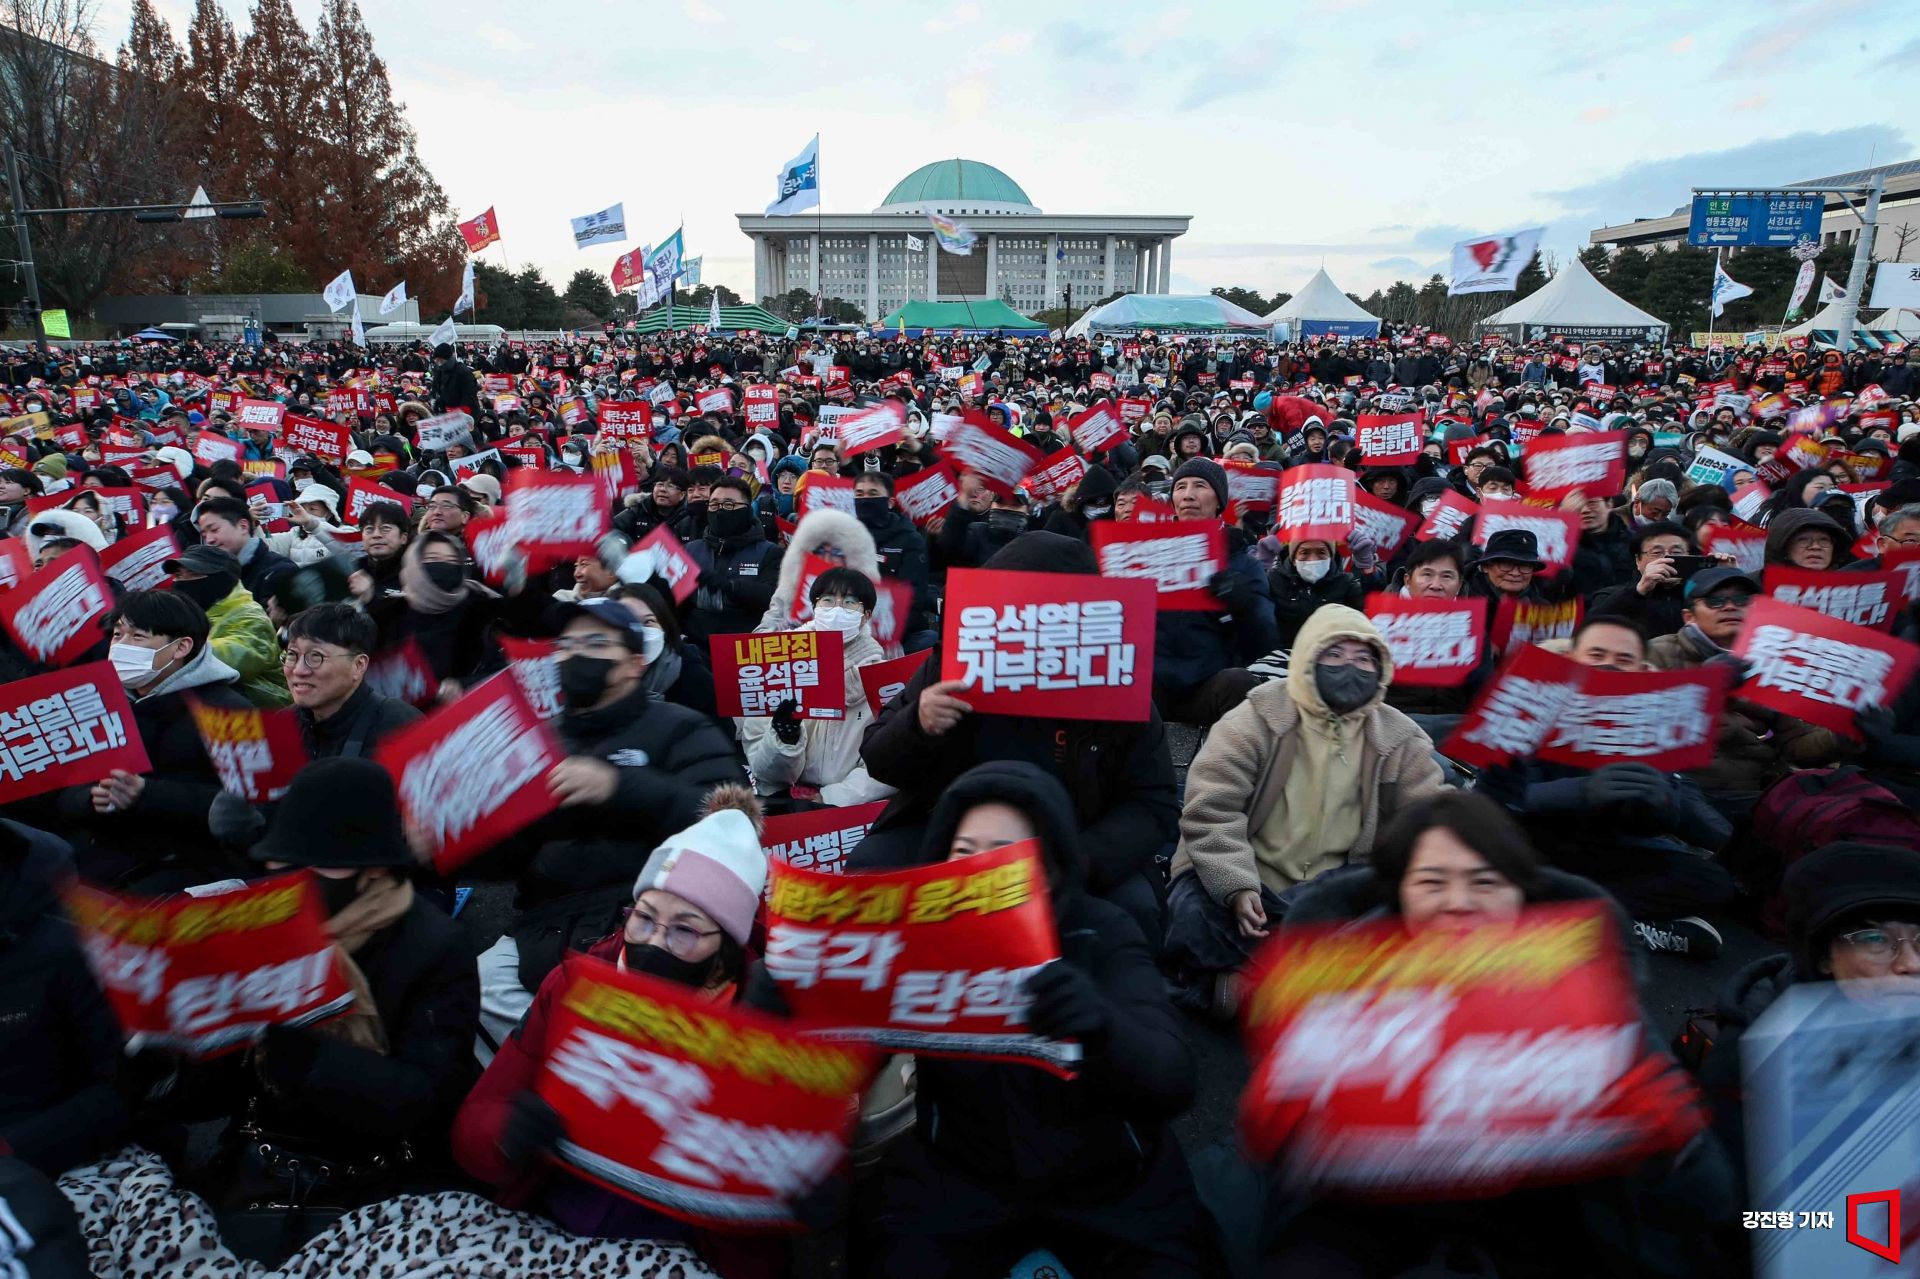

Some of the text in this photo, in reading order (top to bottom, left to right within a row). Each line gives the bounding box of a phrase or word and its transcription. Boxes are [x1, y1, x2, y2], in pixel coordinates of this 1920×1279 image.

[1769, 200, 1814, 211] 신촌로터리
[1706, 217, 1749, 227] 영등포경찰서
[1767, 217, 1802, 226] 서강대교
[1610, 327, 1624, 336] 합동
[1625, 327, 1644, 336] 분향소
[603, 410, 641, 423] 내란수괴
[294, 424, 339, 444] 내란수괴
[626, 423, 647, 435] 체포
[1360, 421, 1415, 441] 윤석열을
[287, 434, 342, 456] 윤석열 체포
[1358, 435, 1419, 458] 거부한다!
[1696, 455, 1728, 472] 내란수괴
[1281, 478, 1347, 506] 윤석열을
[1278, 500, 1351, 529] 거부한다!
[958, 599, 1125, 651] 윤석열을
[735, 632, 818, 666] 내란죄
[738, 660, 820, 693] 윤석열
[957, 643, 1135, 694] 거부한다!
[0, 683, 107, 743] 석열을
[907, 862, 1032, 924] 윤석열
[765, 924, 907, 990] 즉각
